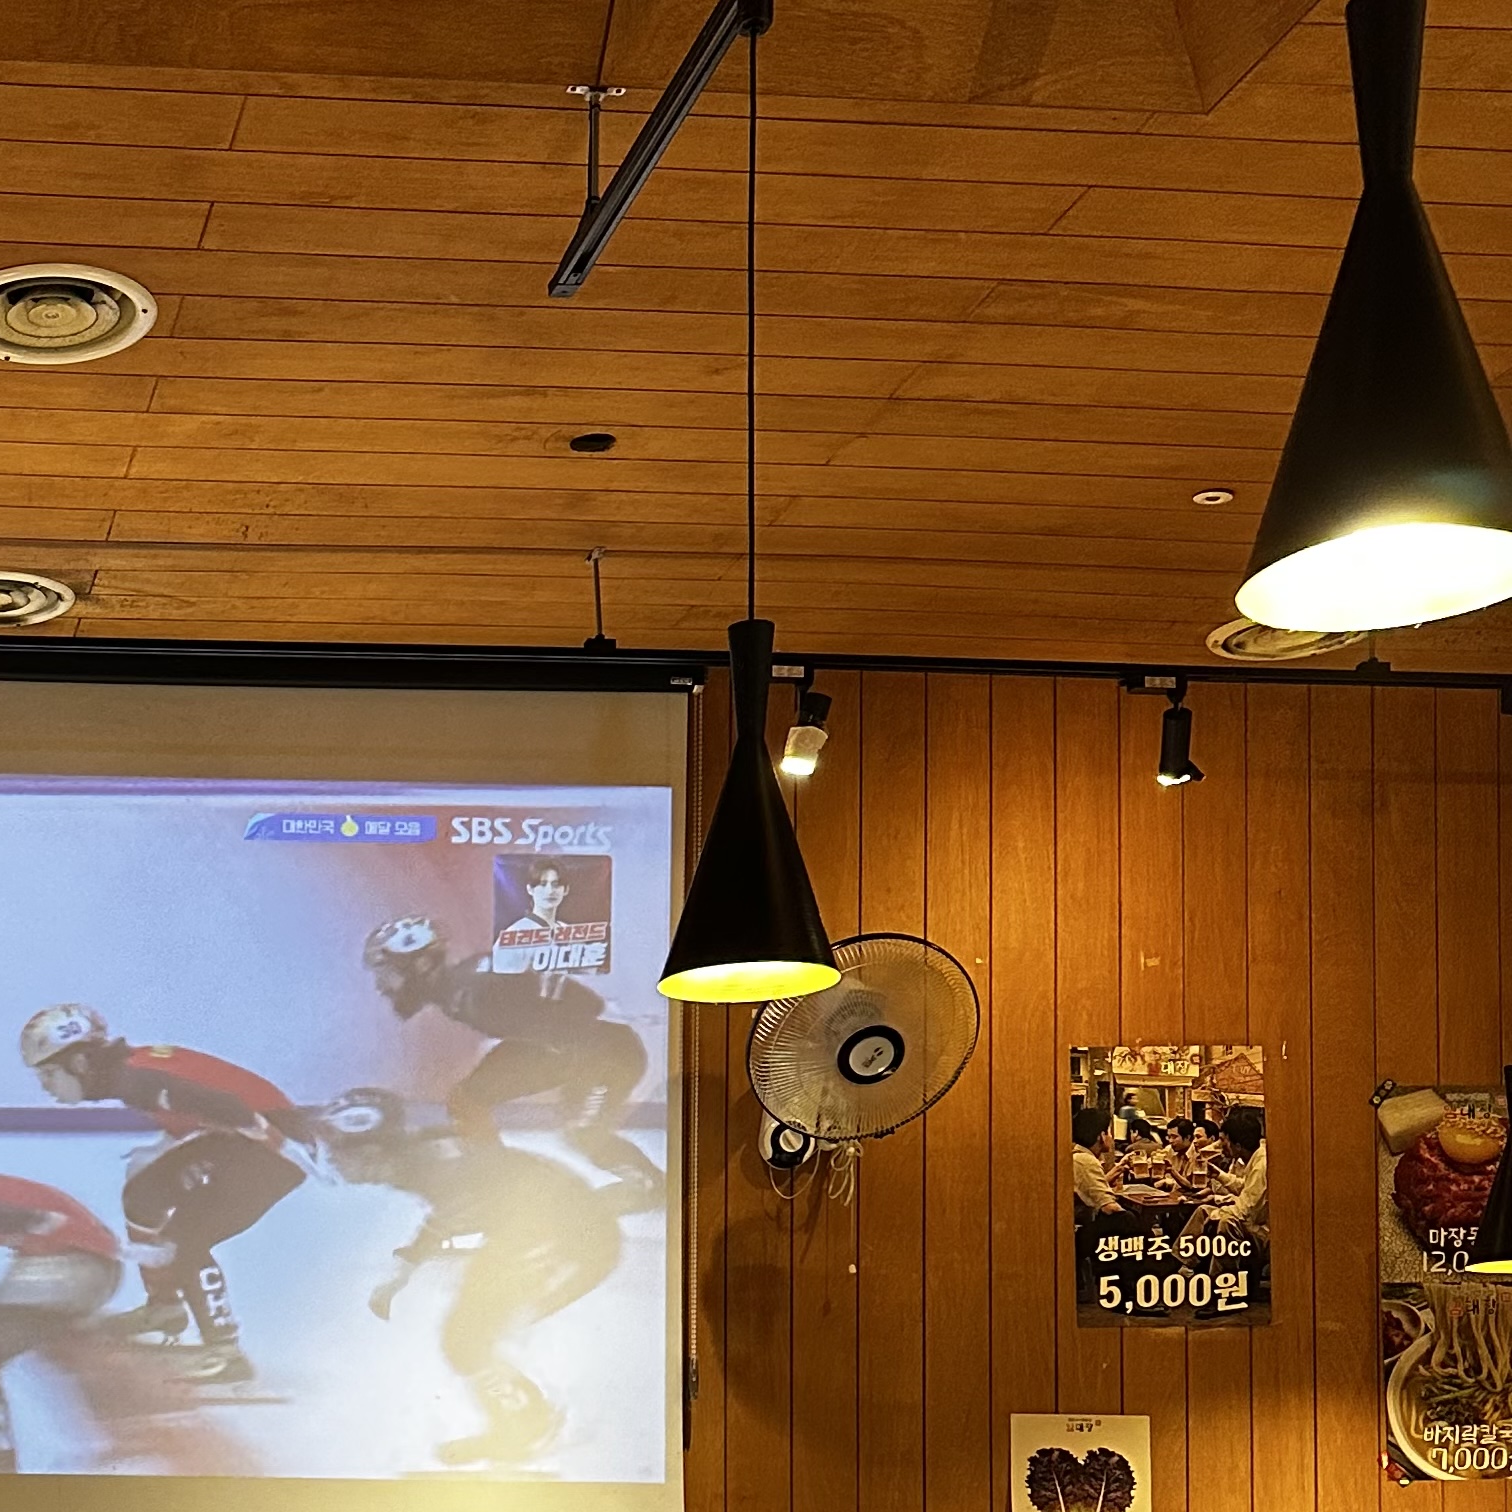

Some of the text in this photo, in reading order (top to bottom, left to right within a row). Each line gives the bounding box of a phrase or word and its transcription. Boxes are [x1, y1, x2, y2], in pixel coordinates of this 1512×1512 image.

[282, 819, 335, 835] 대한민국
[451, 816, 613, 852] SBS Sports
[498, 921, 608, 948] 태권도 레전드
[533, 941, 609, 972] 이대훈
[1094, 1235, 1252, 1262] 생맥주 500cc
[1098, 1271, 1249, 1313] 5,000원
[1431, 1447, 1512, 1474] 7,000
